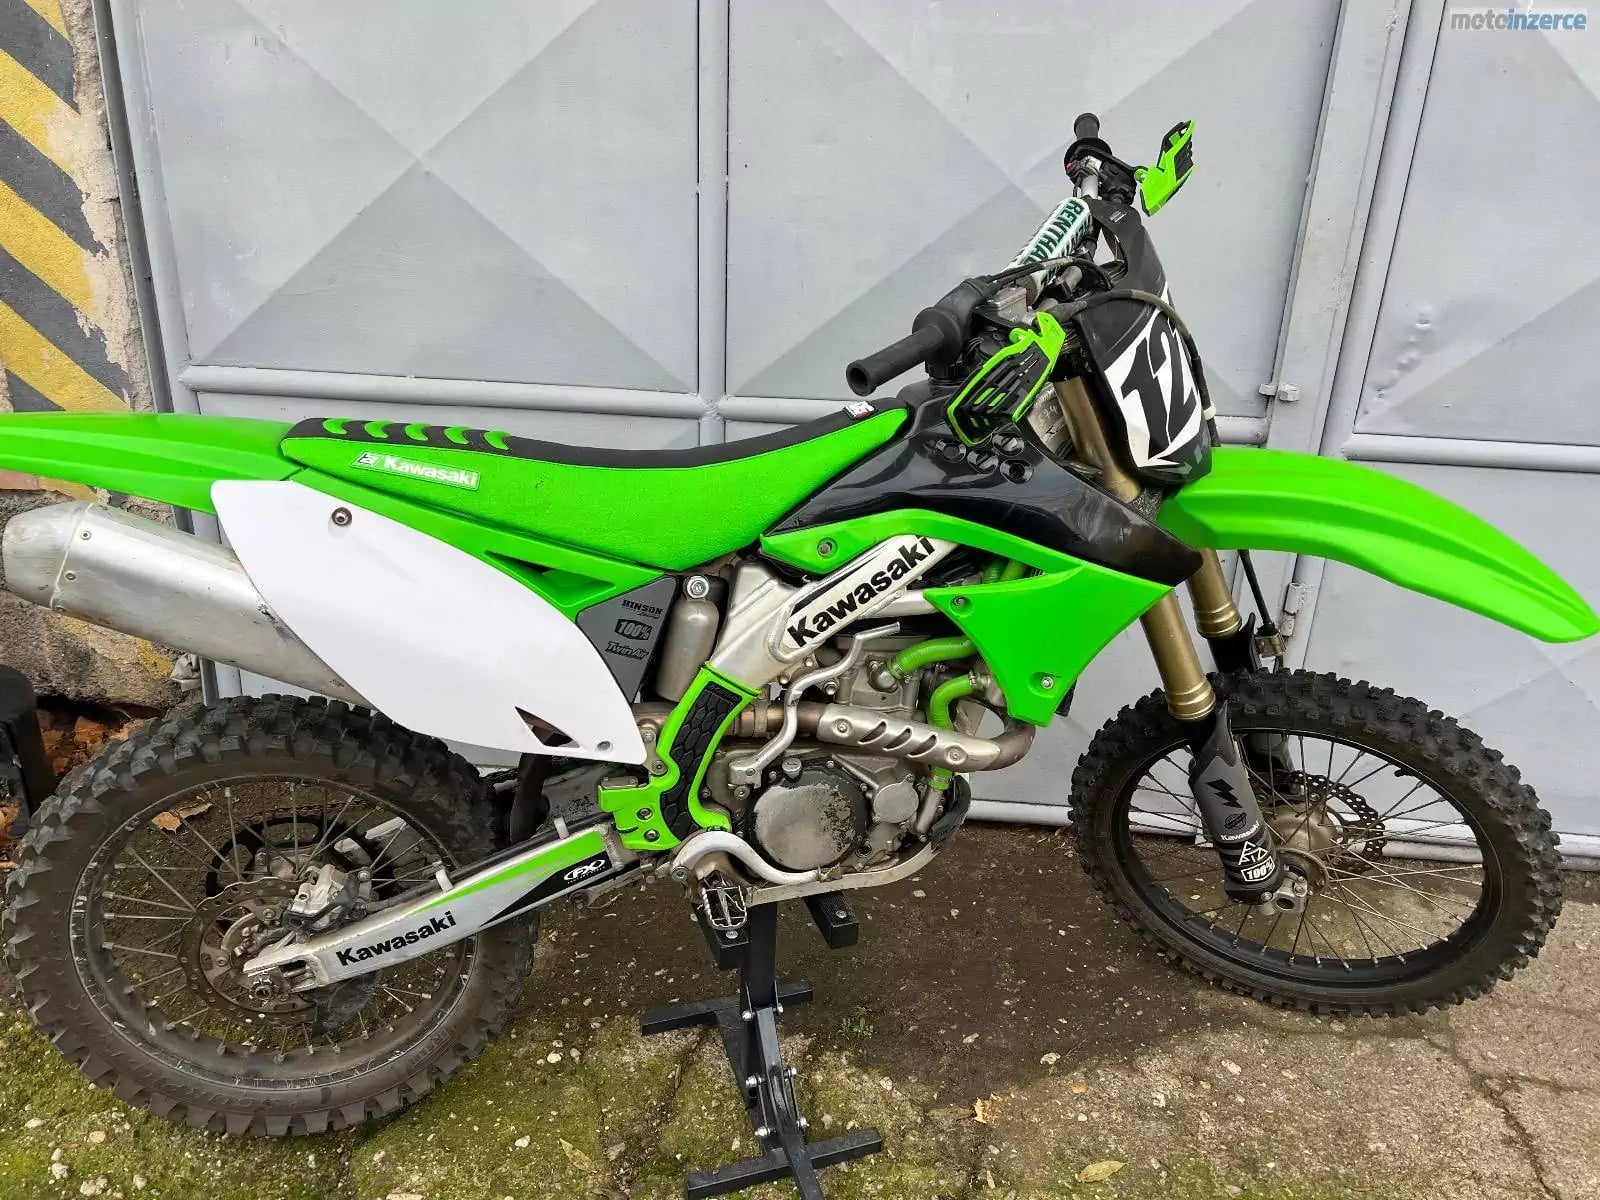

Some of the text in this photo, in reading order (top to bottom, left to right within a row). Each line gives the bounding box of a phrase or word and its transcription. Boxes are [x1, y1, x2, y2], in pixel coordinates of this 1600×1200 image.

[1022, 199, 1085, 264] RENTHA
[1120, 309, 1197, 460] 12
[383, 455, 478, 487] Kawasaki
[621, 599, 663, 615] HINSON
[786, 536, 936, 648] Kawasaki
[616, 620, 652, 640] 100%
[1220, 820, 1260, 841] Kawasaki
[1245, 859, 1274, 880] 100%
[335, 910, 457, 966] Kawasaki
